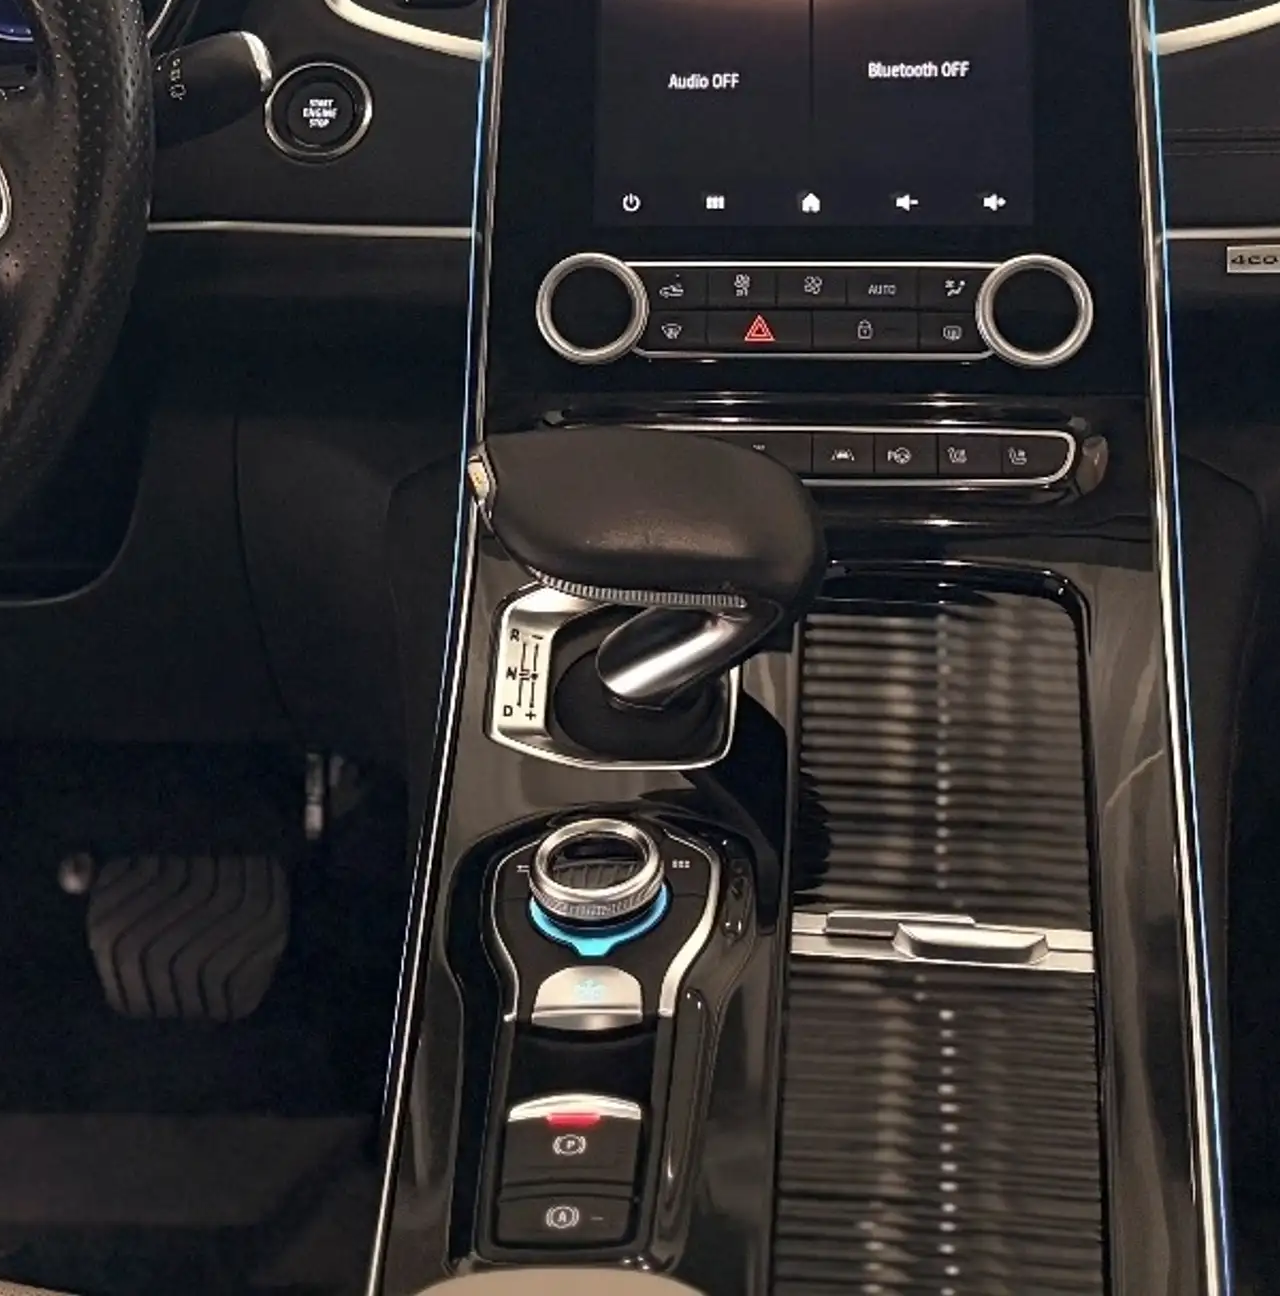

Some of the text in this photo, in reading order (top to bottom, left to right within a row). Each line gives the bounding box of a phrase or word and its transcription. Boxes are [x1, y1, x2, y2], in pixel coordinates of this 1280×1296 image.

[868, 60, 970, 78] Bluetooth OFF
[668, 73, 740, 90] Audio OFF
[868, 283, 897, 296] AUTO
[509, 628, 520, 642] R
[505, 666, 518, 681] N
[502, 704, 514, 718] D
